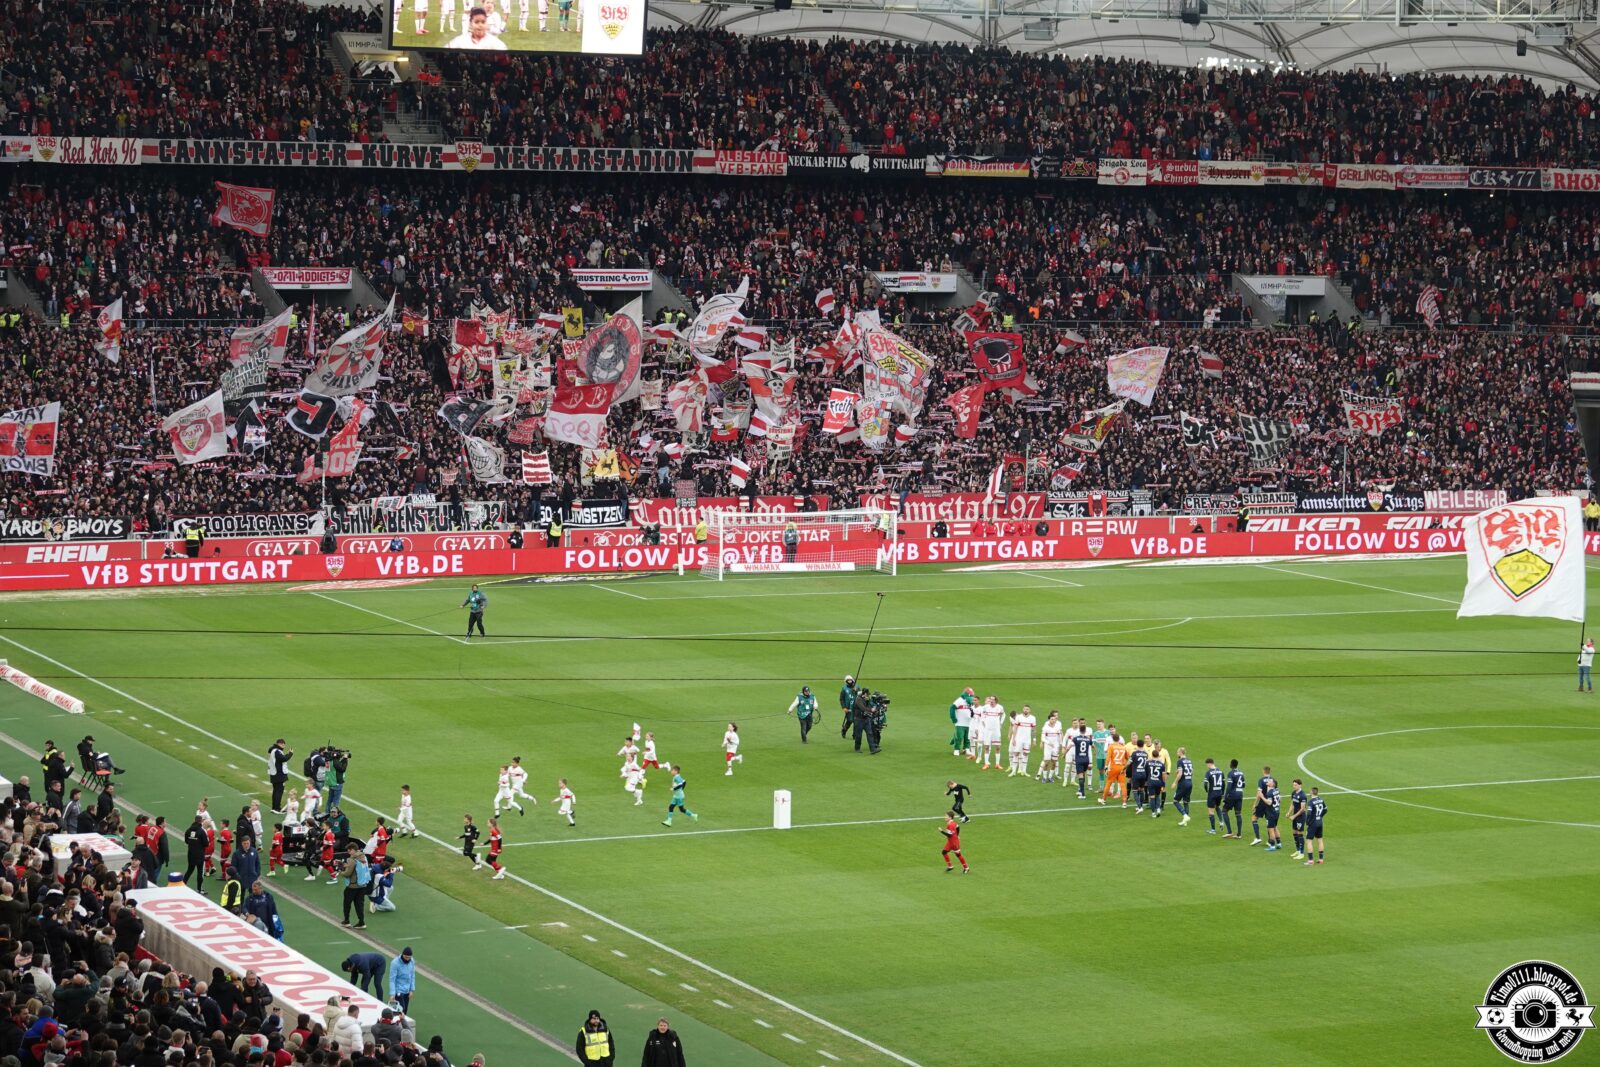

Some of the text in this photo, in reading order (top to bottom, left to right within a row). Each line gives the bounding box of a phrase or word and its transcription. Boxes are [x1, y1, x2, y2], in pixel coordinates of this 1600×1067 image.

[60, 136, 137, 164] Red Hots 96
[159, 140, 443, 169] CANNSTATTER KURVE
[717, 150, 787, 163] ALBSTADT
[493, 147, 694, 173] NECKARSTADION
[787, 155, 926, 170] NECKAR-FILS STUTTGART
[1100, 158, 1147, 169] Brigada Loca
[719, 161, 785, 175] VFB-FANS
[1340, 169, 1393, 184] GERLINGEN
[1010, 494, 1042, 520] 97
[1185, 497, 1220, 509] CREW
[0, 517, 124, 536] YARD BWOYS
[196, 514, 309, 534] HOOLIGANS
[1245, 517, 1361, 532] FALKEN
[1130, 536, 1207, 556] VfB.DE
[1294, 532, 1386, 552] FOLLOW
[1394, 532, 1420, 550] US
[26, 545, 109, 564] EHEIM
[565, 544, 784, 569] FOLLOW US @VfB
[878, 539, 1059, 562] VfB STUTTGART
[376, 553, 464, 575] VfB.DE
[81, 559, 293, 585] VfB STUTTGART
[1079, 741, 1087, 753] 8
[1113, 749, 1126, 762] 27
[1149, 766, 1160, 776] 15
[1183, 763, 1193, 776] 33
[1212, 774, 1223, 787] 14
[1237, 776, 1243, 788] 6
[1315, 803, 1324, 816] 19
